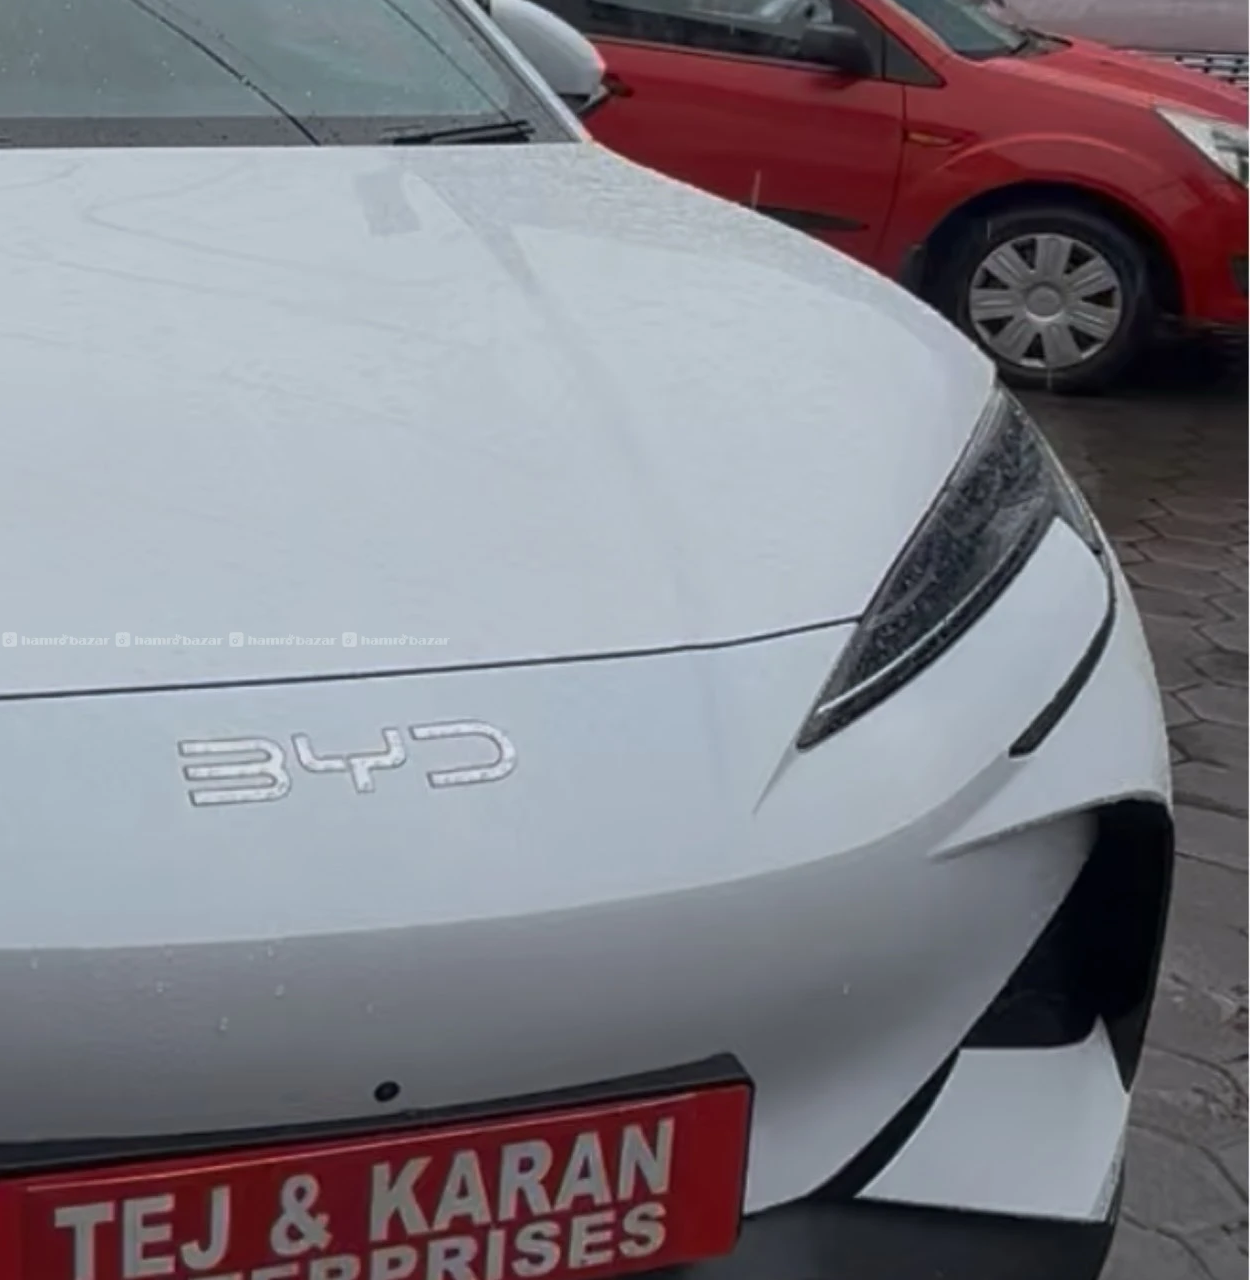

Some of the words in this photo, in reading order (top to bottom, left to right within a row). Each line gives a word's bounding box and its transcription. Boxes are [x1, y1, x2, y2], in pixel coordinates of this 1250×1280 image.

[177, 718, 518, 807] BYD
[269, 1174, 332, 1259] &
[369, 1117, 675, 1242] KARAN
